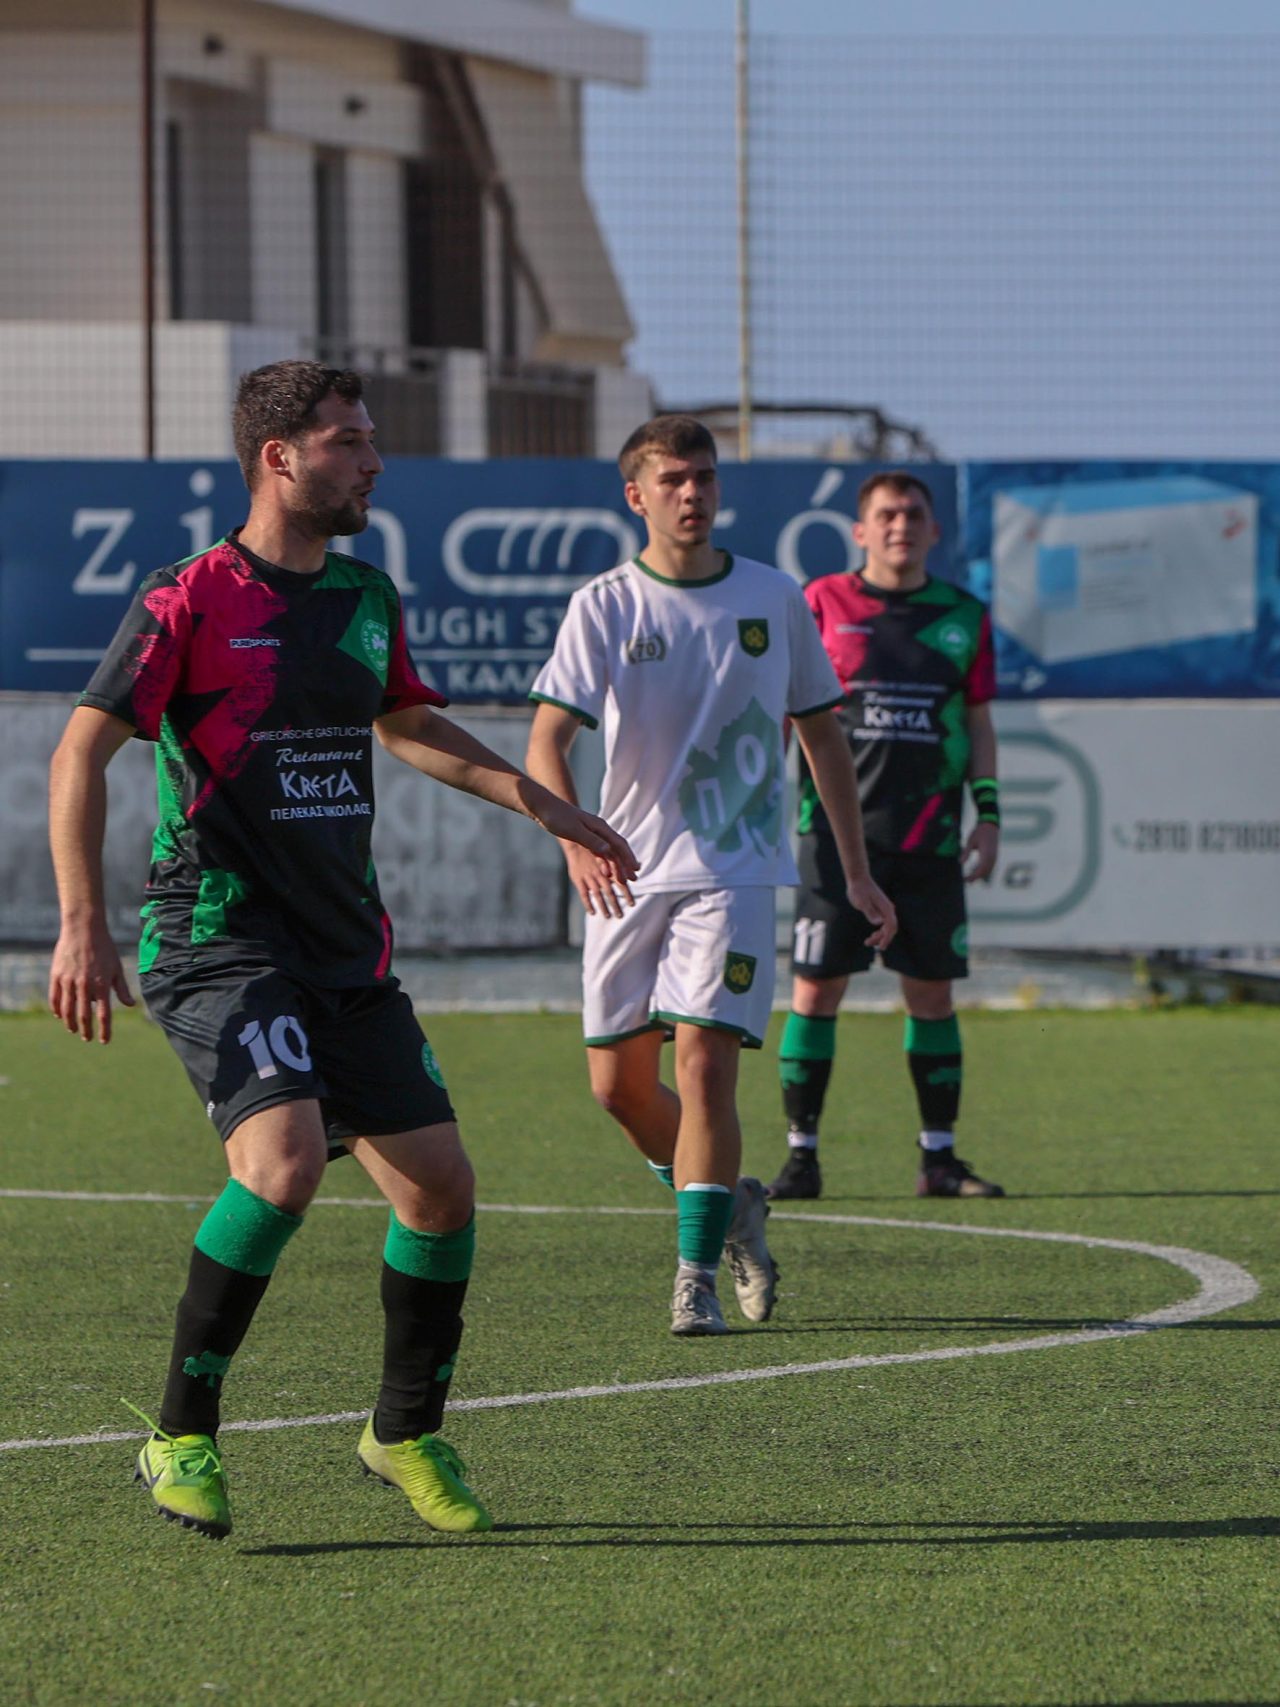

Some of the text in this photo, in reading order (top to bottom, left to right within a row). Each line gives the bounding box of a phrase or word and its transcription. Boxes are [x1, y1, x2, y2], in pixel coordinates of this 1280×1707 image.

[405, 606, 508, 646] UGH
[280, 768, 359, 800] KRETA
[793, 916, 828, 966] 11
[236, 1014, 313, 1081] 10
